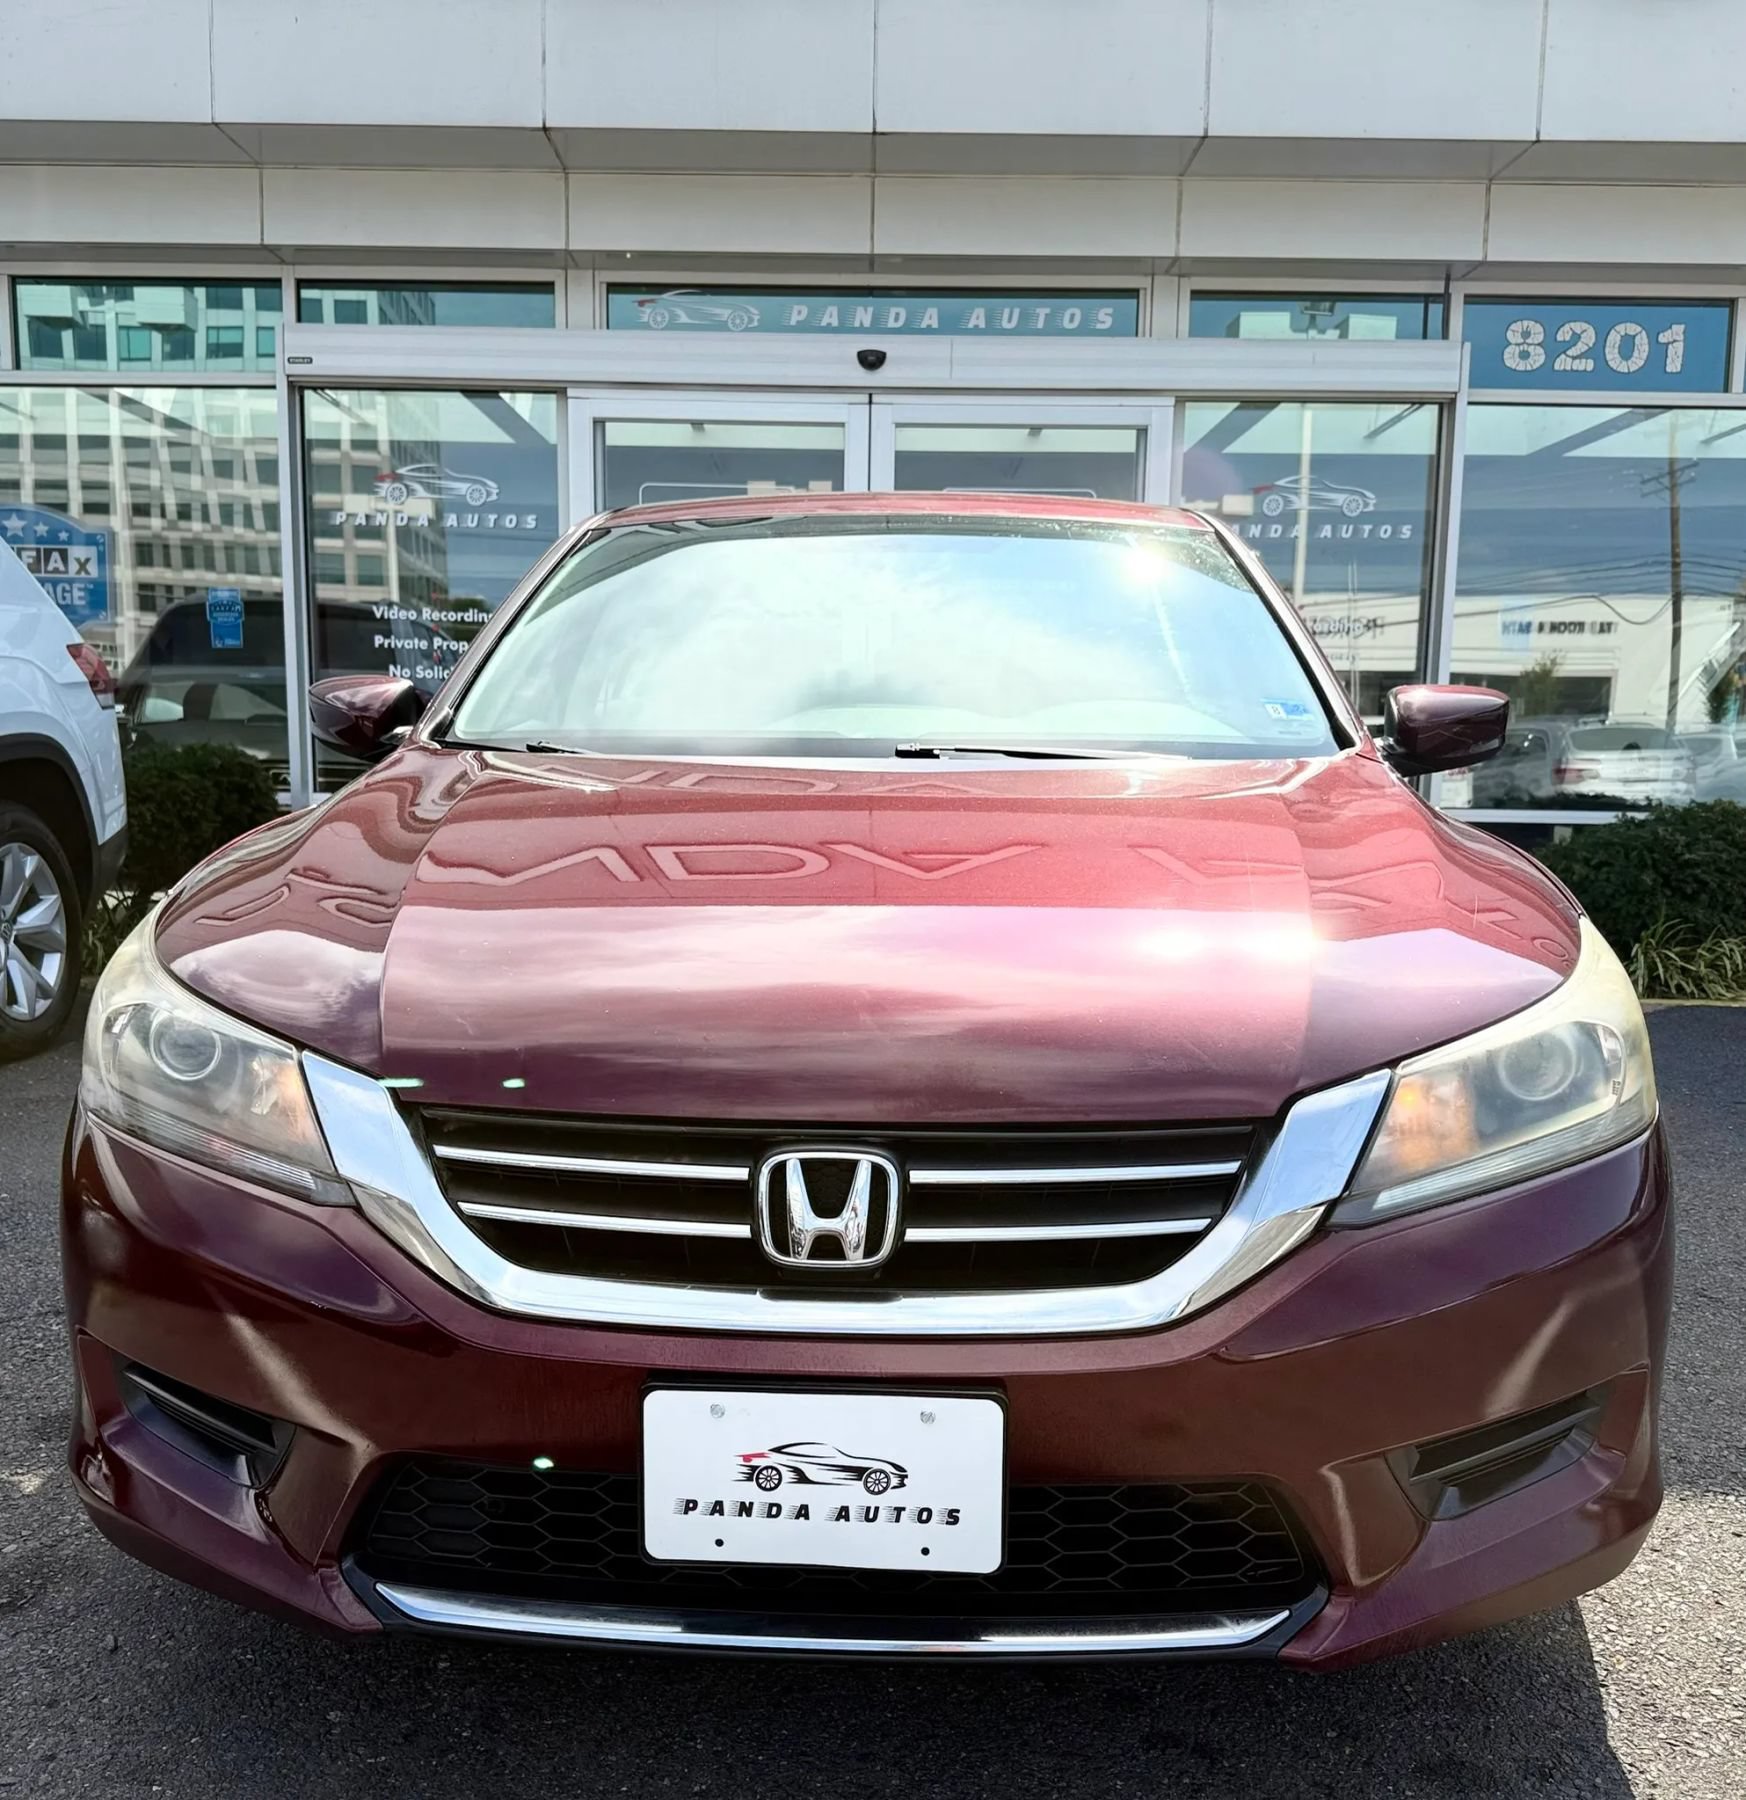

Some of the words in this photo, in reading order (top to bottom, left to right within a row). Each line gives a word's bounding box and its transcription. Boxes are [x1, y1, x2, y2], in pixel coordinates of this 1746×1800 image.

[785, 304, 939, 329] PANDA
[961, 306, 1114, 329] AUTOS
[1503, 319, 1686, 373] 8201
[332, 511, 429, 527] PANDA
[446, 513, 538, 529] AUTOS
[1232, 524, 1300, 539] ANDA
[1319, 524, 1412, 539] AUTOS
[372, 604, 418, 620] Video
[373, 634, 429, 650] Private
[433, 636, 470, 654] Prop
[388, 664, 412, 679] No
[675, 1497, 810, 1522] PANDA
[827, 1505, 961, 1526] AUTOS
